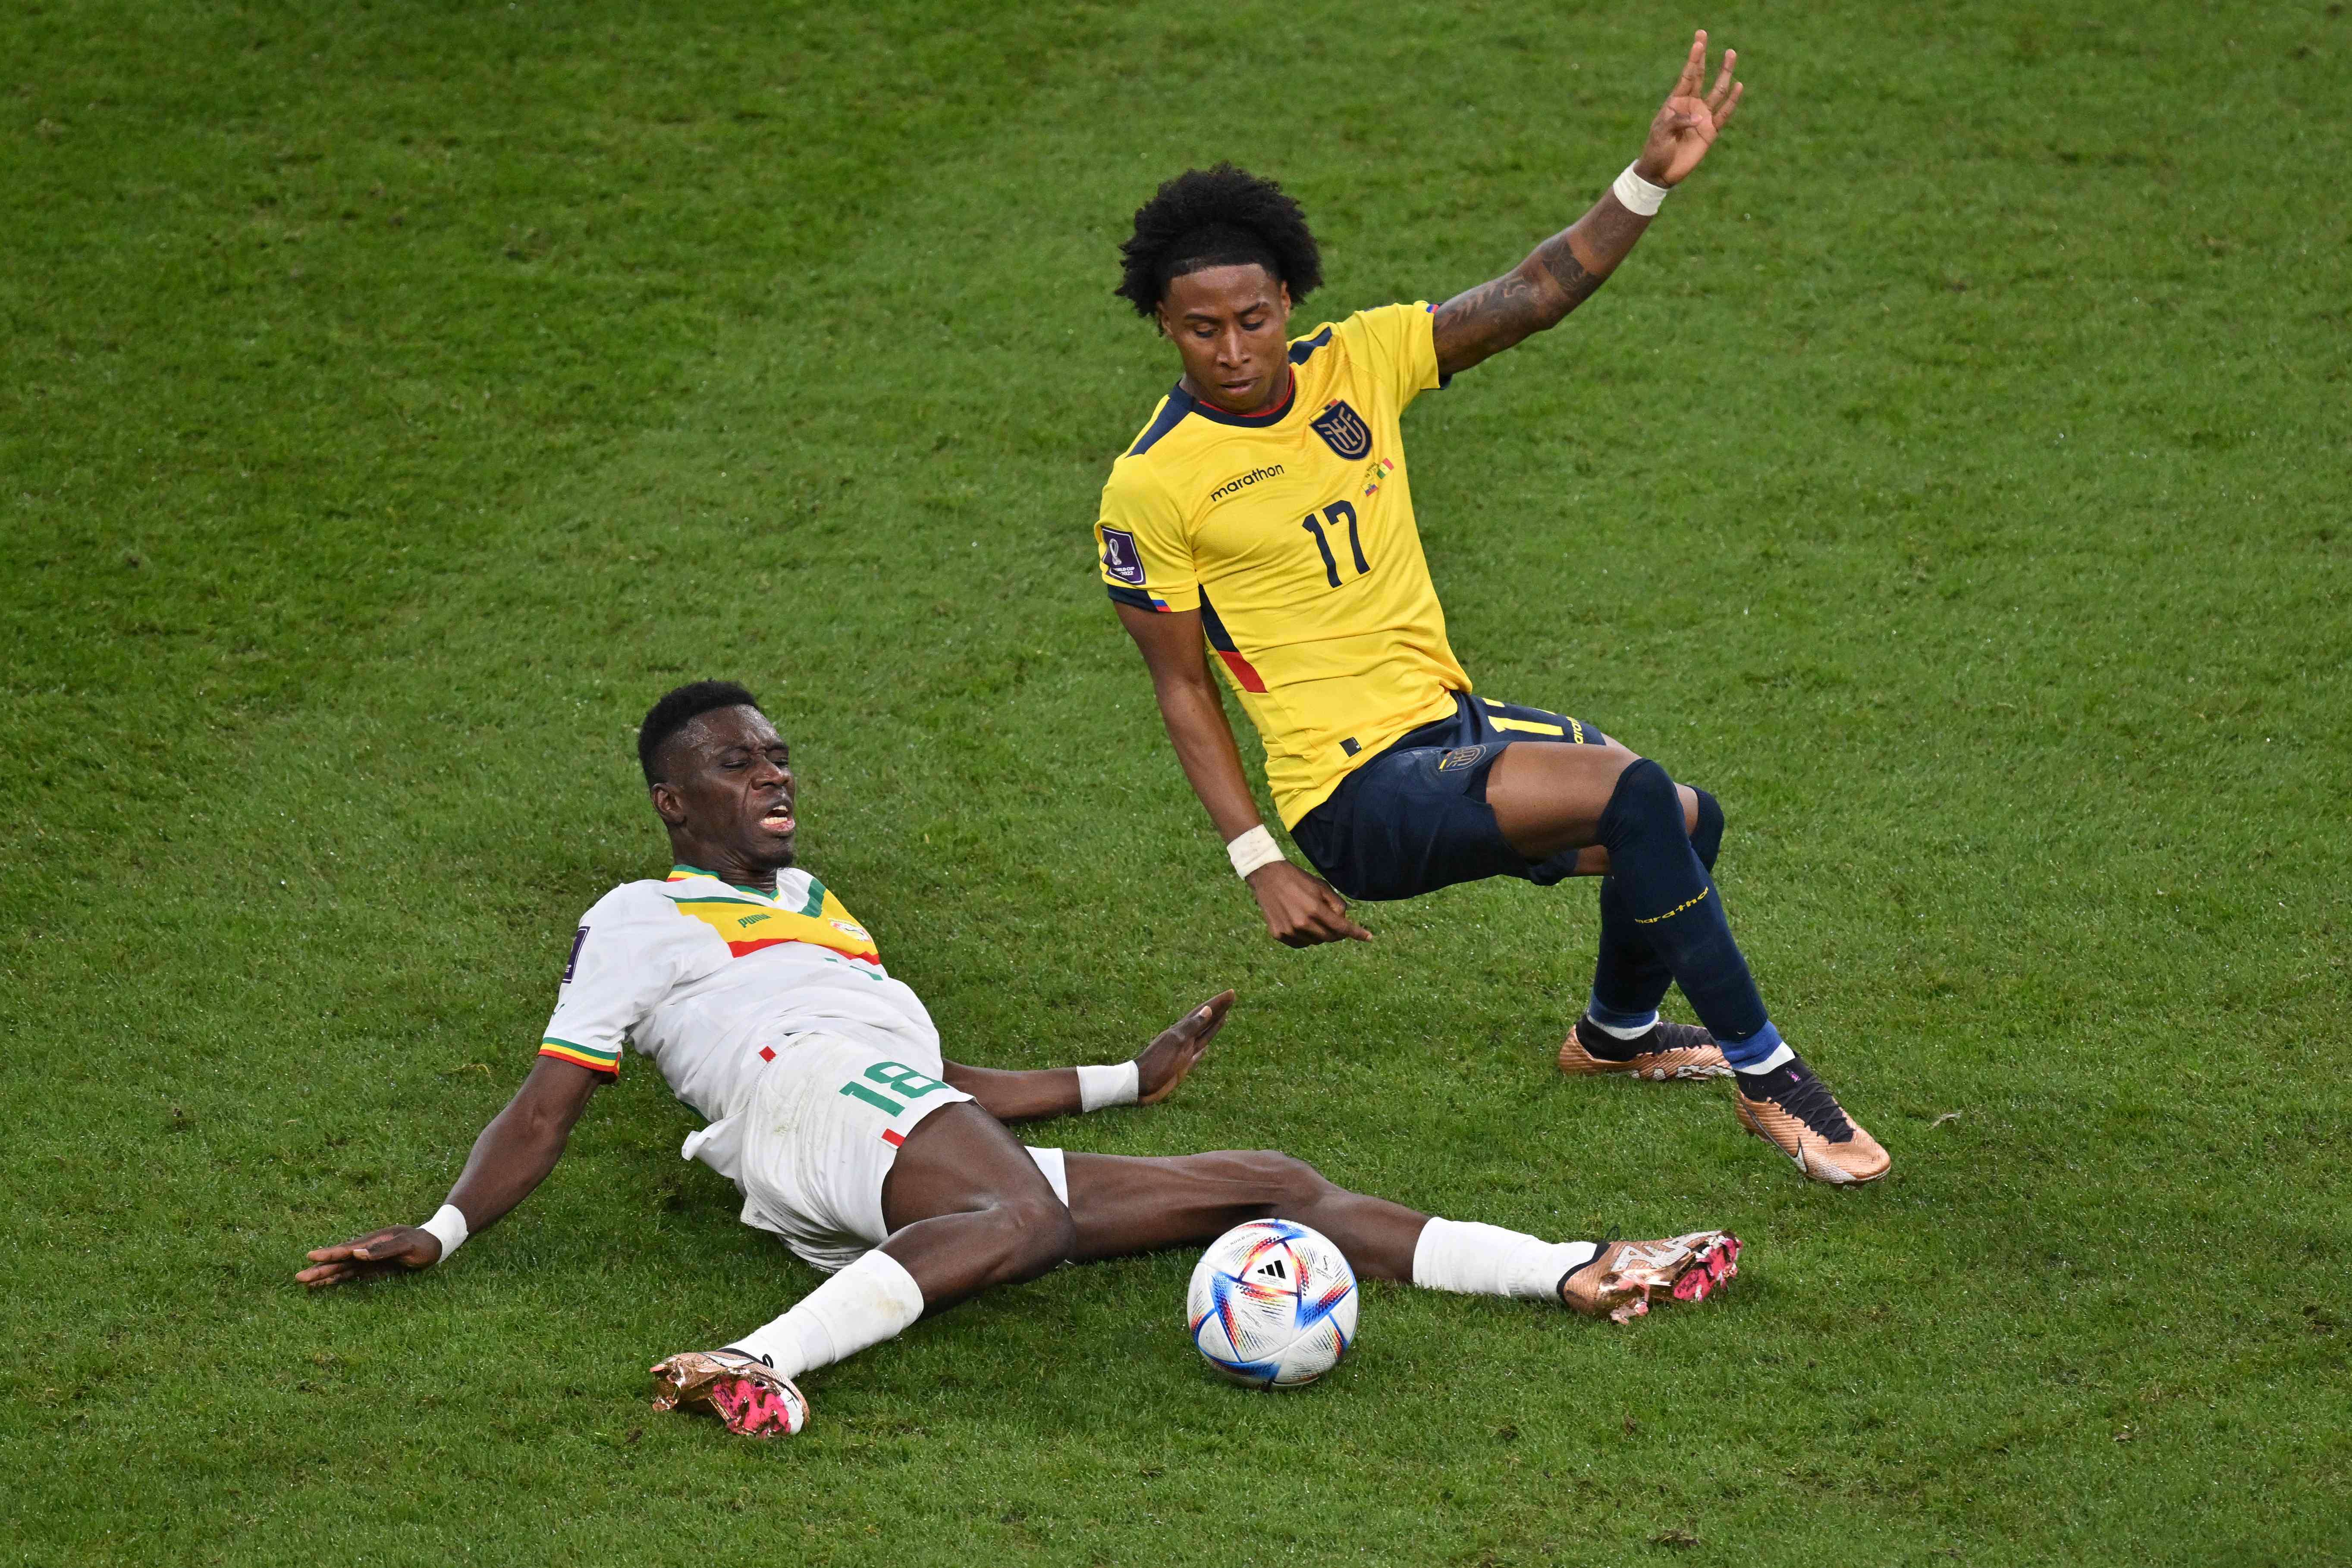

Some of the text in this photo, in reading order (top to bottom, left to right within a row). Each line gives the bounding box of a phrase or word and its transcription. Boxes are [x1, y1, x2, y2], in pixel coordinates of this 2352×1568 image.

[1211, 464, 1284, 502] marathon
[1302, 500, 1371, 588] 17
[737, 914, 772, 928] PUMA
[838, 1061, 950, 1118] 18
